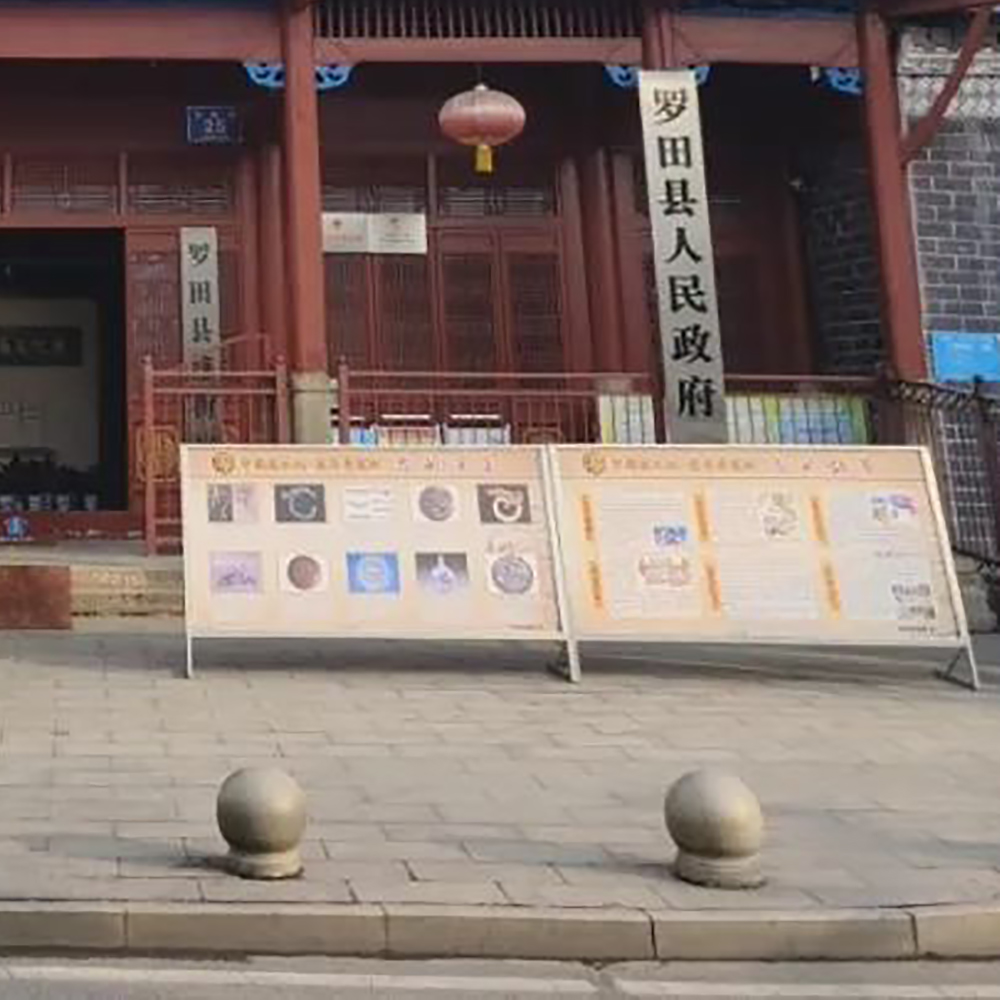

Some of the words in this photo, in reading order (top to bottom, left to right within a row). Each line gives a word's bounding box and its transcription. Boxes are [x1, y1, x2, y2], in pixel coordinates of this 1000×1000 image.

[653, 87, 716, 418] 罗田县人民政府
